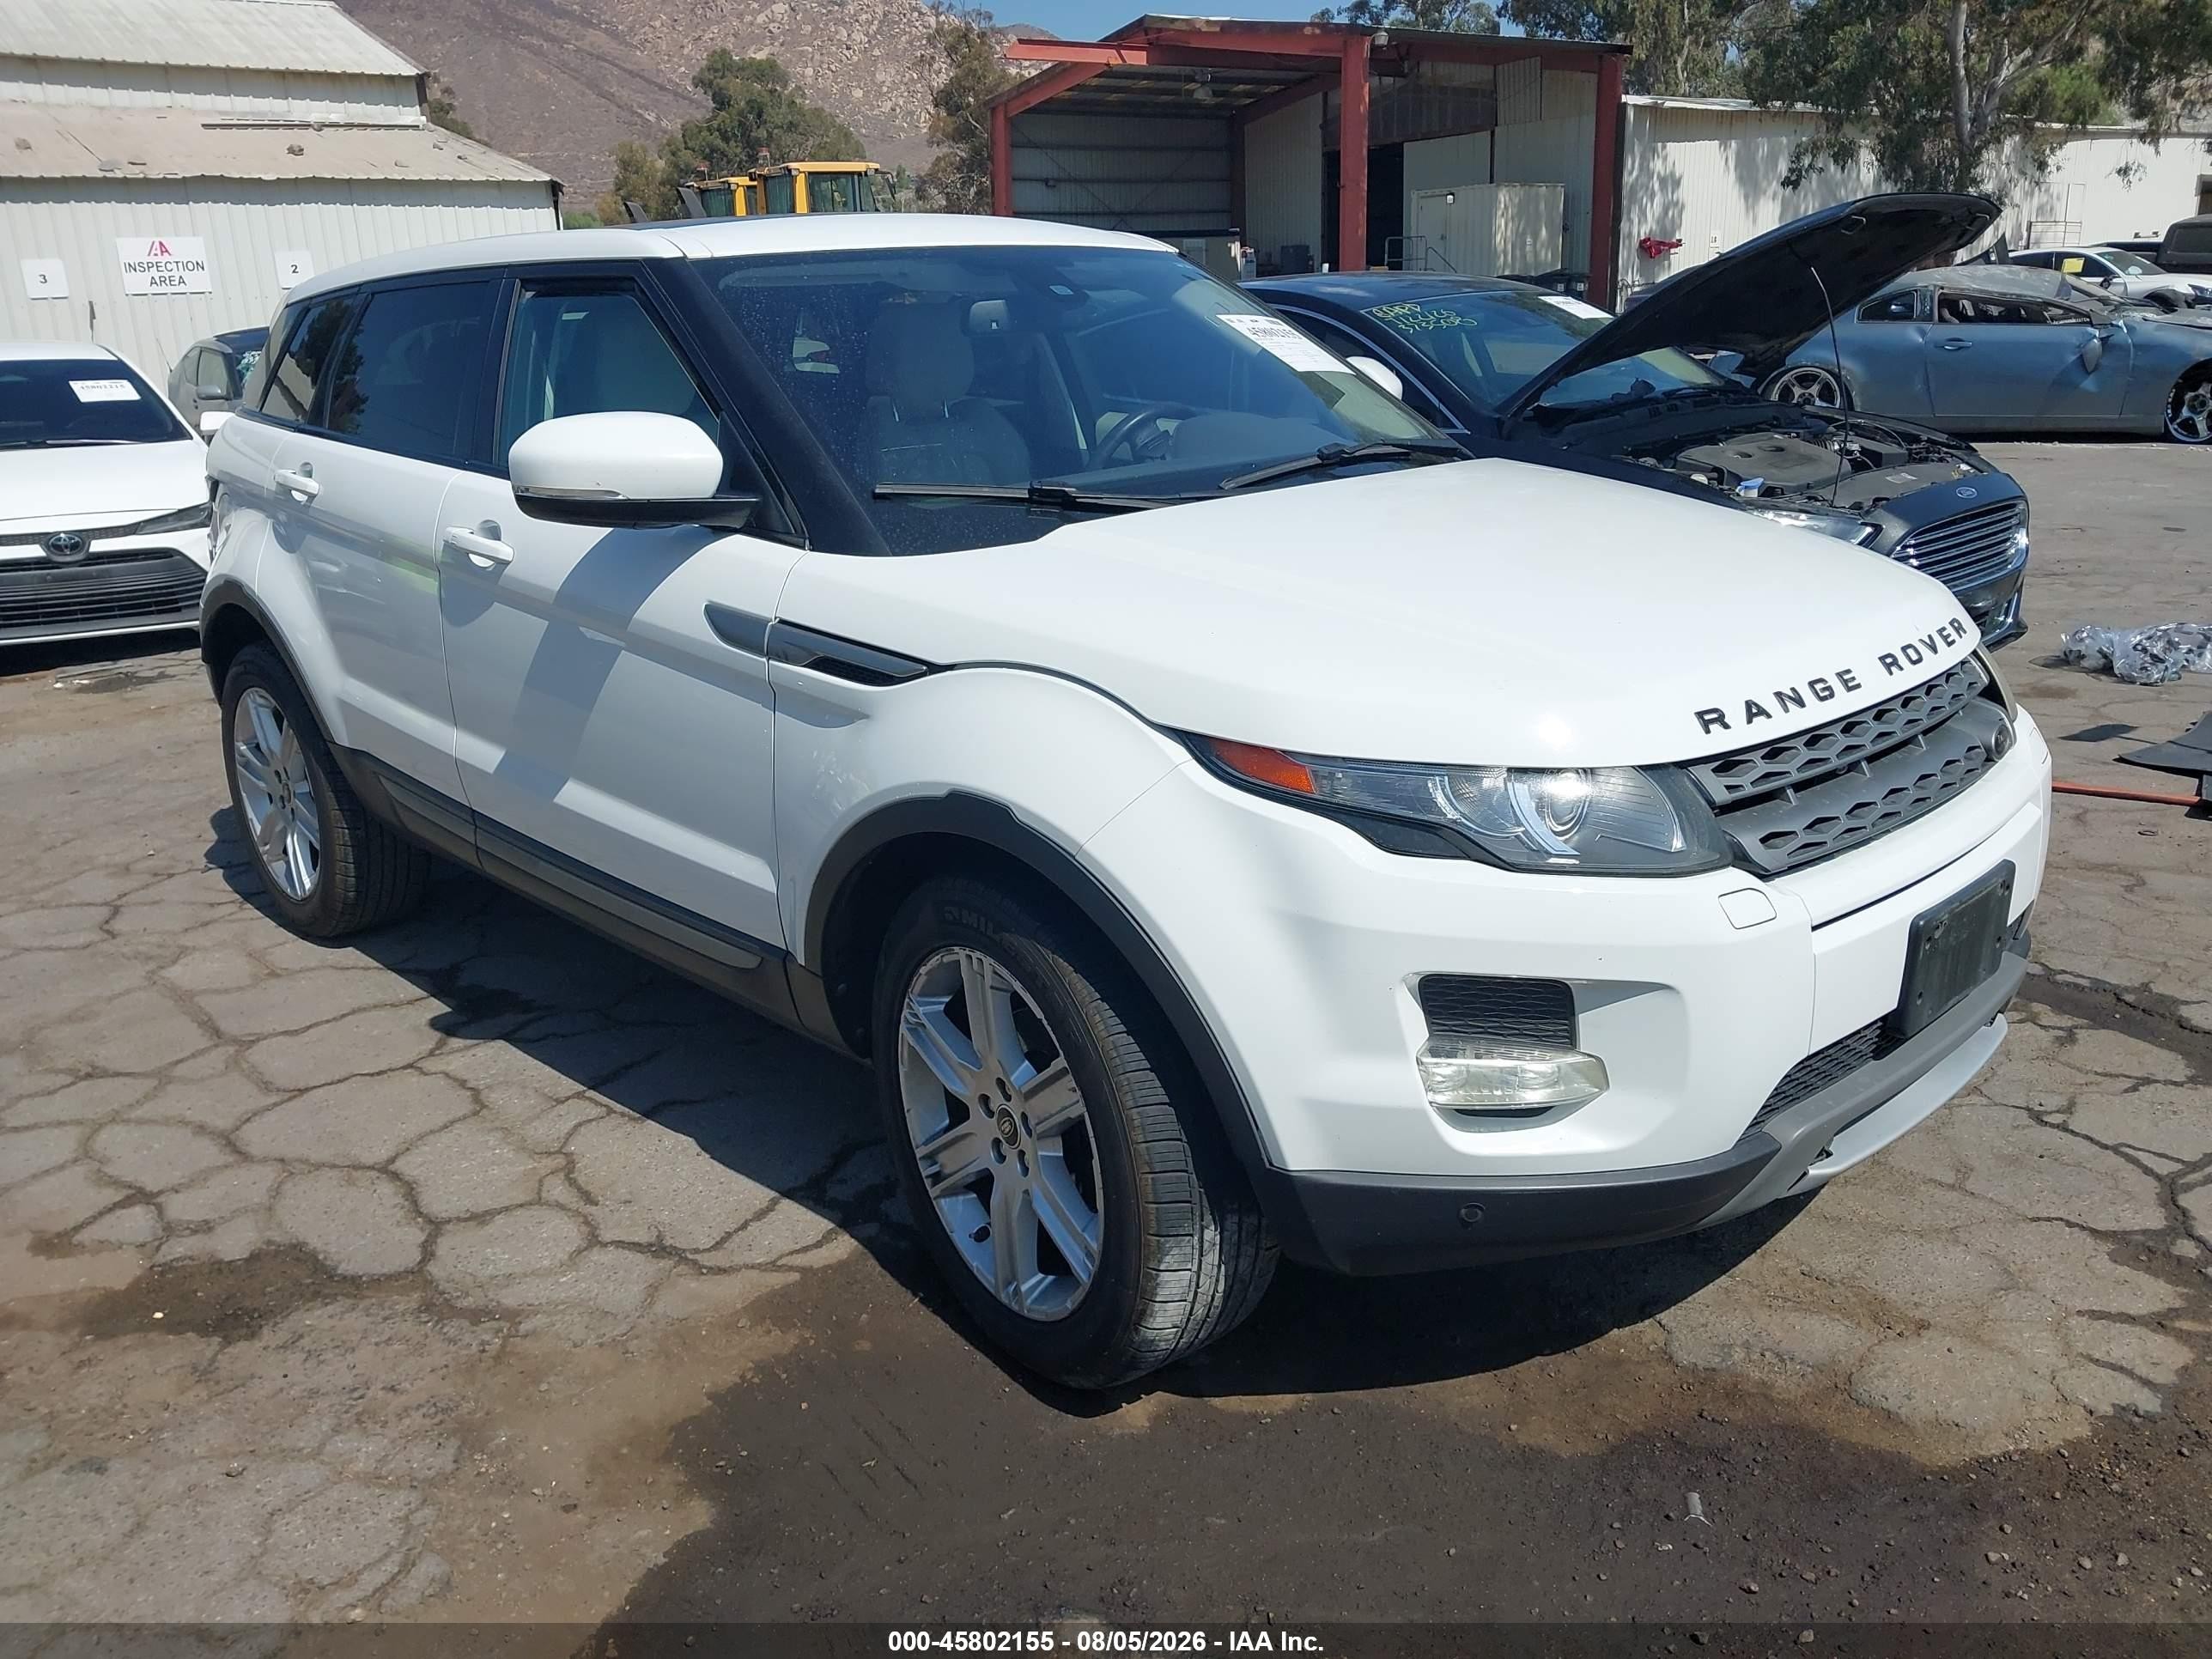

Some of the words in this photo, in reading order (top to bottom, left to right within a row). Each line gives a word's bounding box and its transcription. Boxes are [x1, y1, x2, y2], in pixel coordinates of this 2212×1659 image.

[124, 260, 205, 273] INSPECTION
[290, 264, 300, 274] 2
[39, 274, 48, 284] 3
[149, 275, 187, 288] AREA
[1694, 668, 1863, 734] RANGE
[1877, 617, 1968, 677] ROVER
